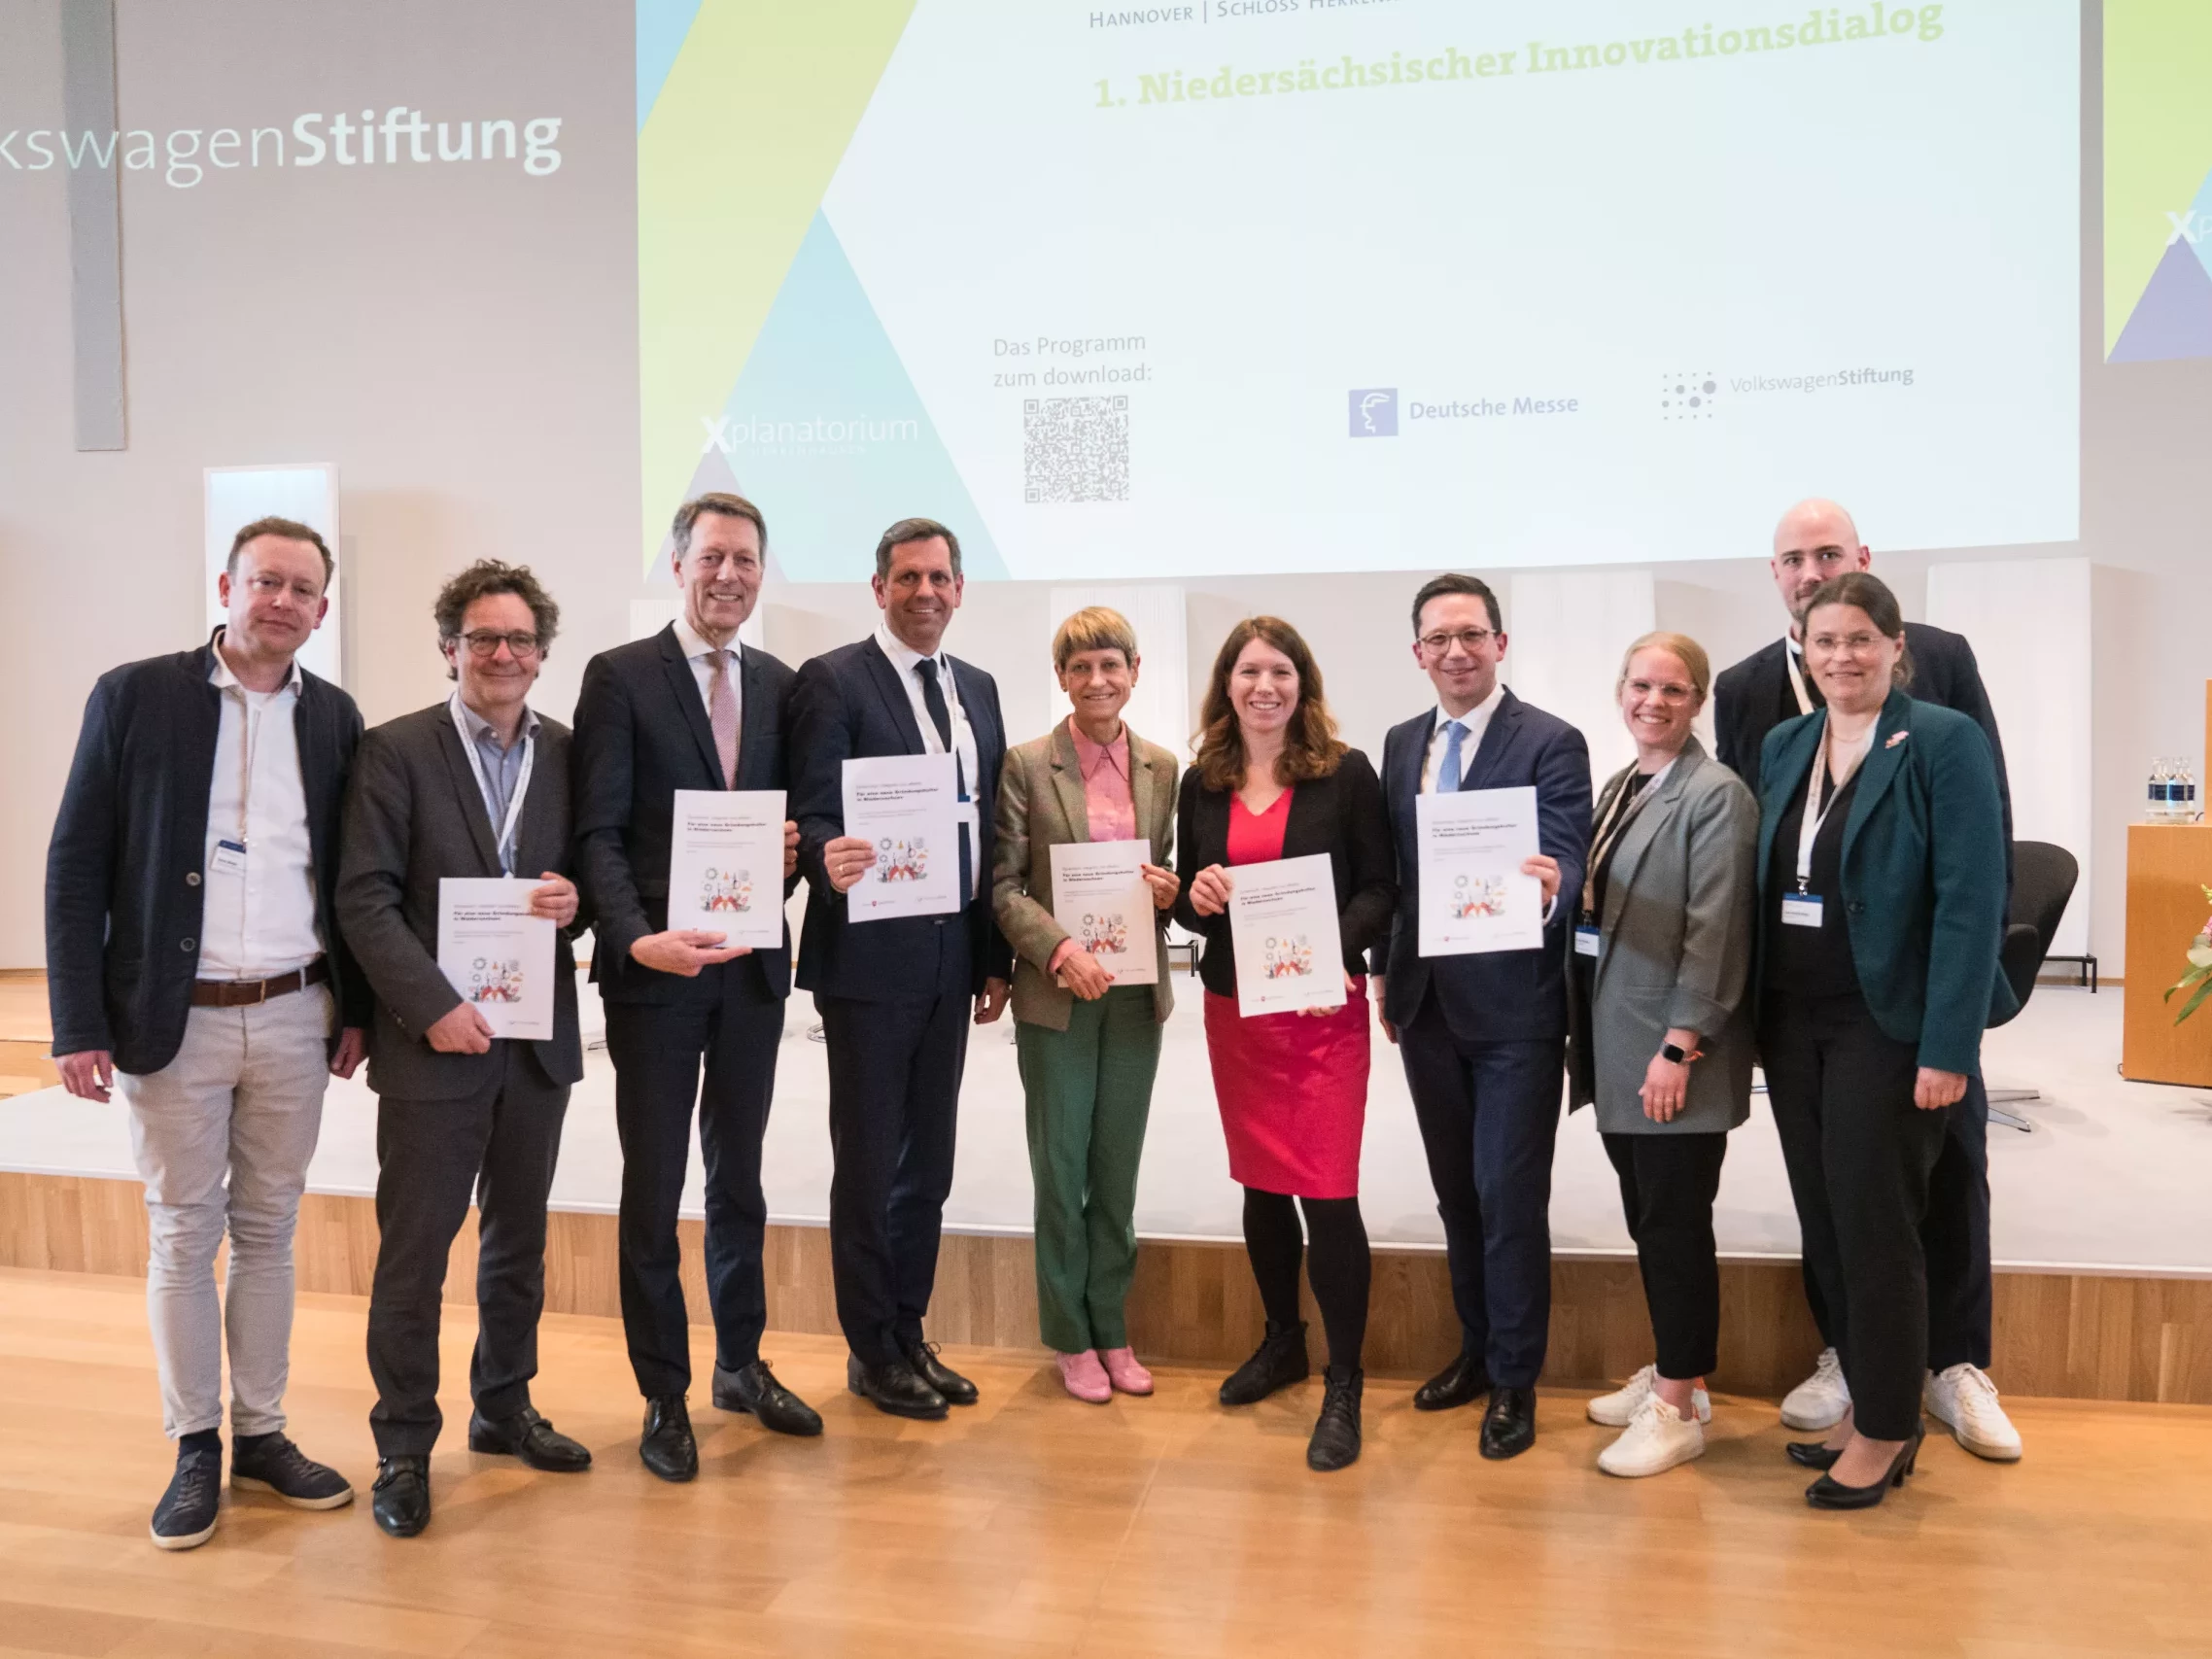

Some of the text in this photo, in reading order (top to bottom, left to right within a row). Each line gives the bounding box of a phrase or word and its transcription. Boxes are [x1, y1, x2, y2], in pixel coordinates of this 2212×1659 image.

[1093, 1, 1946, 108] 1. Niedersächsischer Innovationsdialog
[993, 335, 1146, 358] Das Programm
[993, 363, 1153, 387] zum download:
[1731, 366, 1915, 393] VolkswagenStiftung
[1409, 397, 1579, 420] Deutsche Messe
[700, 413, 919, 454] Xplanatorium
